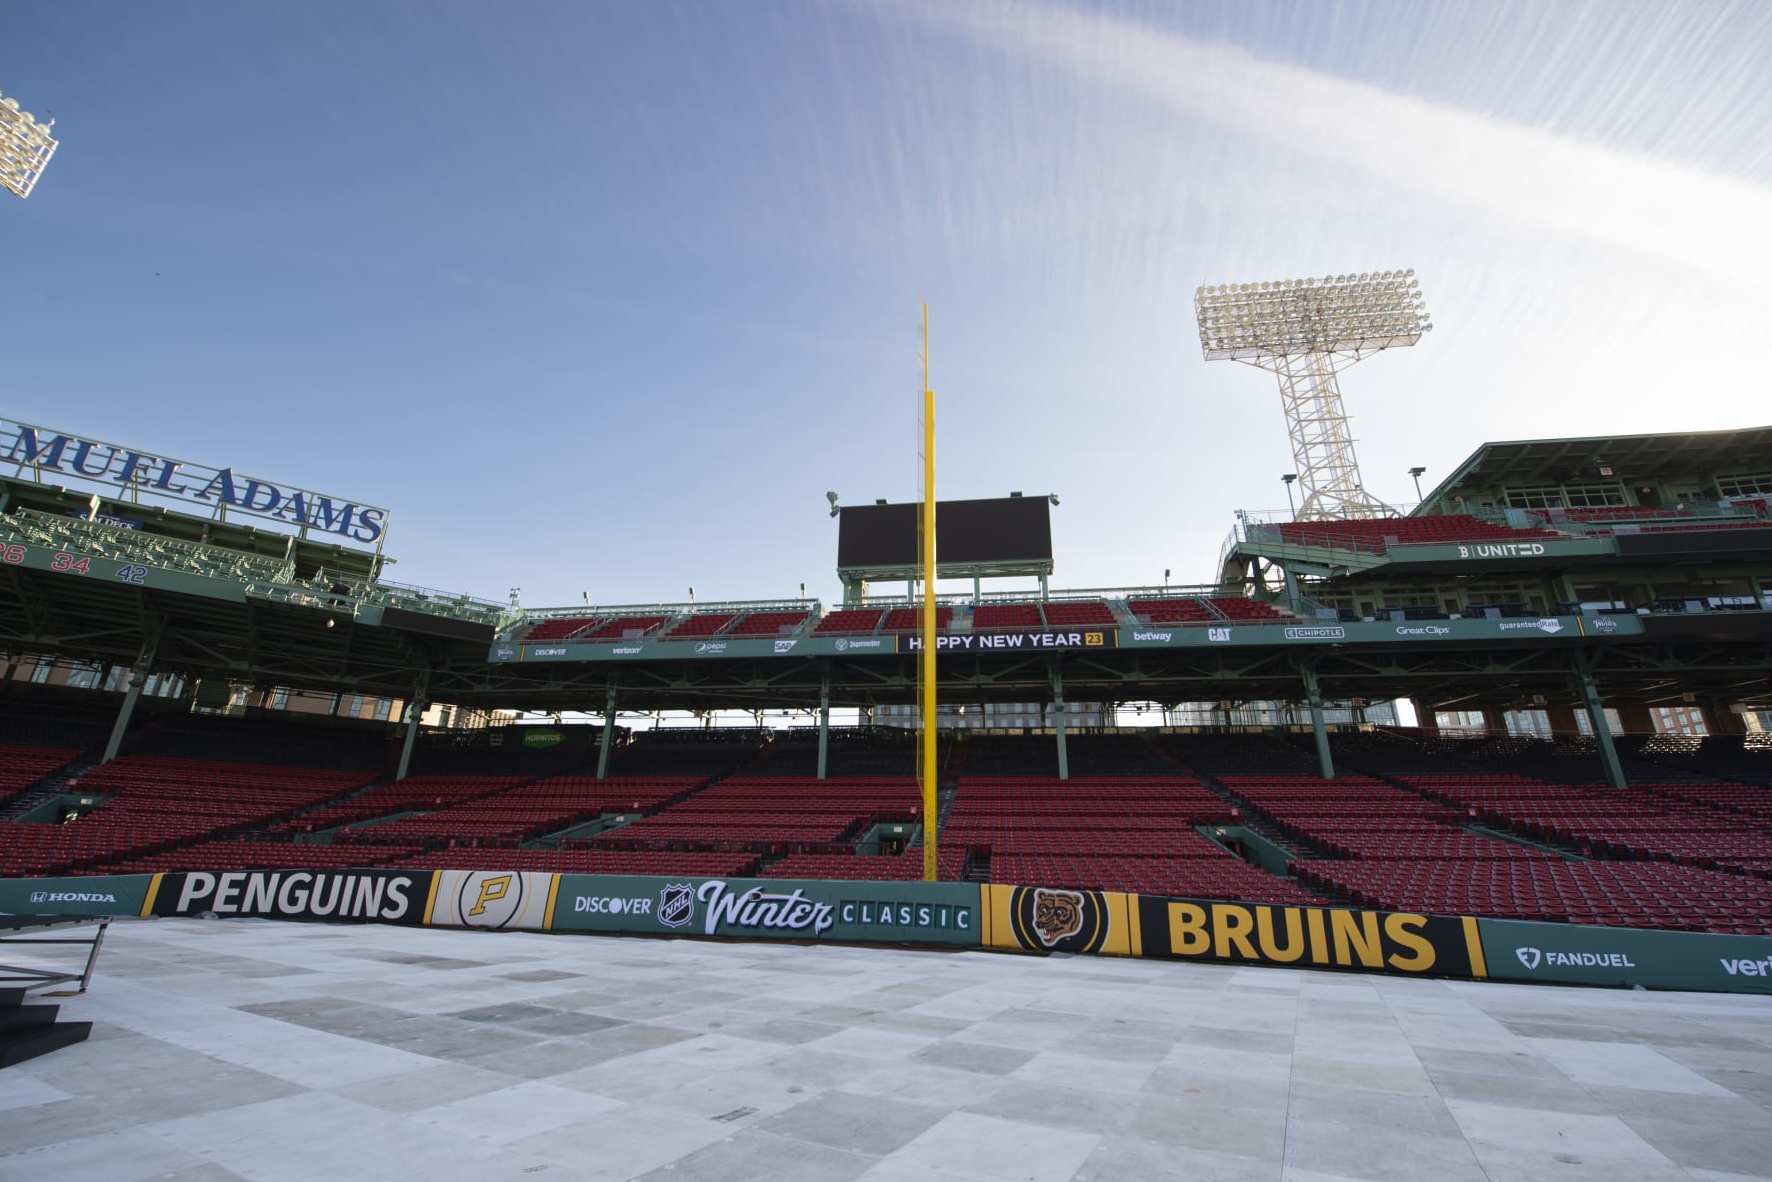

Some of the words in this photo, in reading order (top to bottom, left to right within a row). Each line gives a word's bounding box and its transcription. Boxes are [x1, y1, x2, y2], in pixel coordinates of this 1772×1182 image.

[194, 467, 385, 544] ADAMS
[1477, 543, 1545, 557] UNITED
[51, 552, 91, 575] 34
[115, 564, 147, 585] 42
[1133, 631, 1172, 643] betway
[1209, 628, 1231, 642] CAT
[1298, 629, 1343, 638] CHIPOTLE
[1396, 626, 1424, 635] Great
[1425, 625, 1450, 637] Clips
[775, 641, 793, 652] SAP
[909, 636, 974, 650] HPPY
[979, 634, 1023, 649] NEW
[1028, 633, 1081, 647] YEAR
[1087, 635, 1102, 644] 23
[49, 892, 117, 903] HONDA
[175, 871, 412, 919] PENGUINS
[468, 876, 513, 917] P
[575, 896, 652, 914] DISCOVER
[664, 893, 690, 918] NHL
[697, 880, 834, 936] Winter
[843, 904, 969, 928] CLASSIC
[1167, 902, 1437, 972] BRUINS
[1546, 953, 1636, 967] FANDUEL
